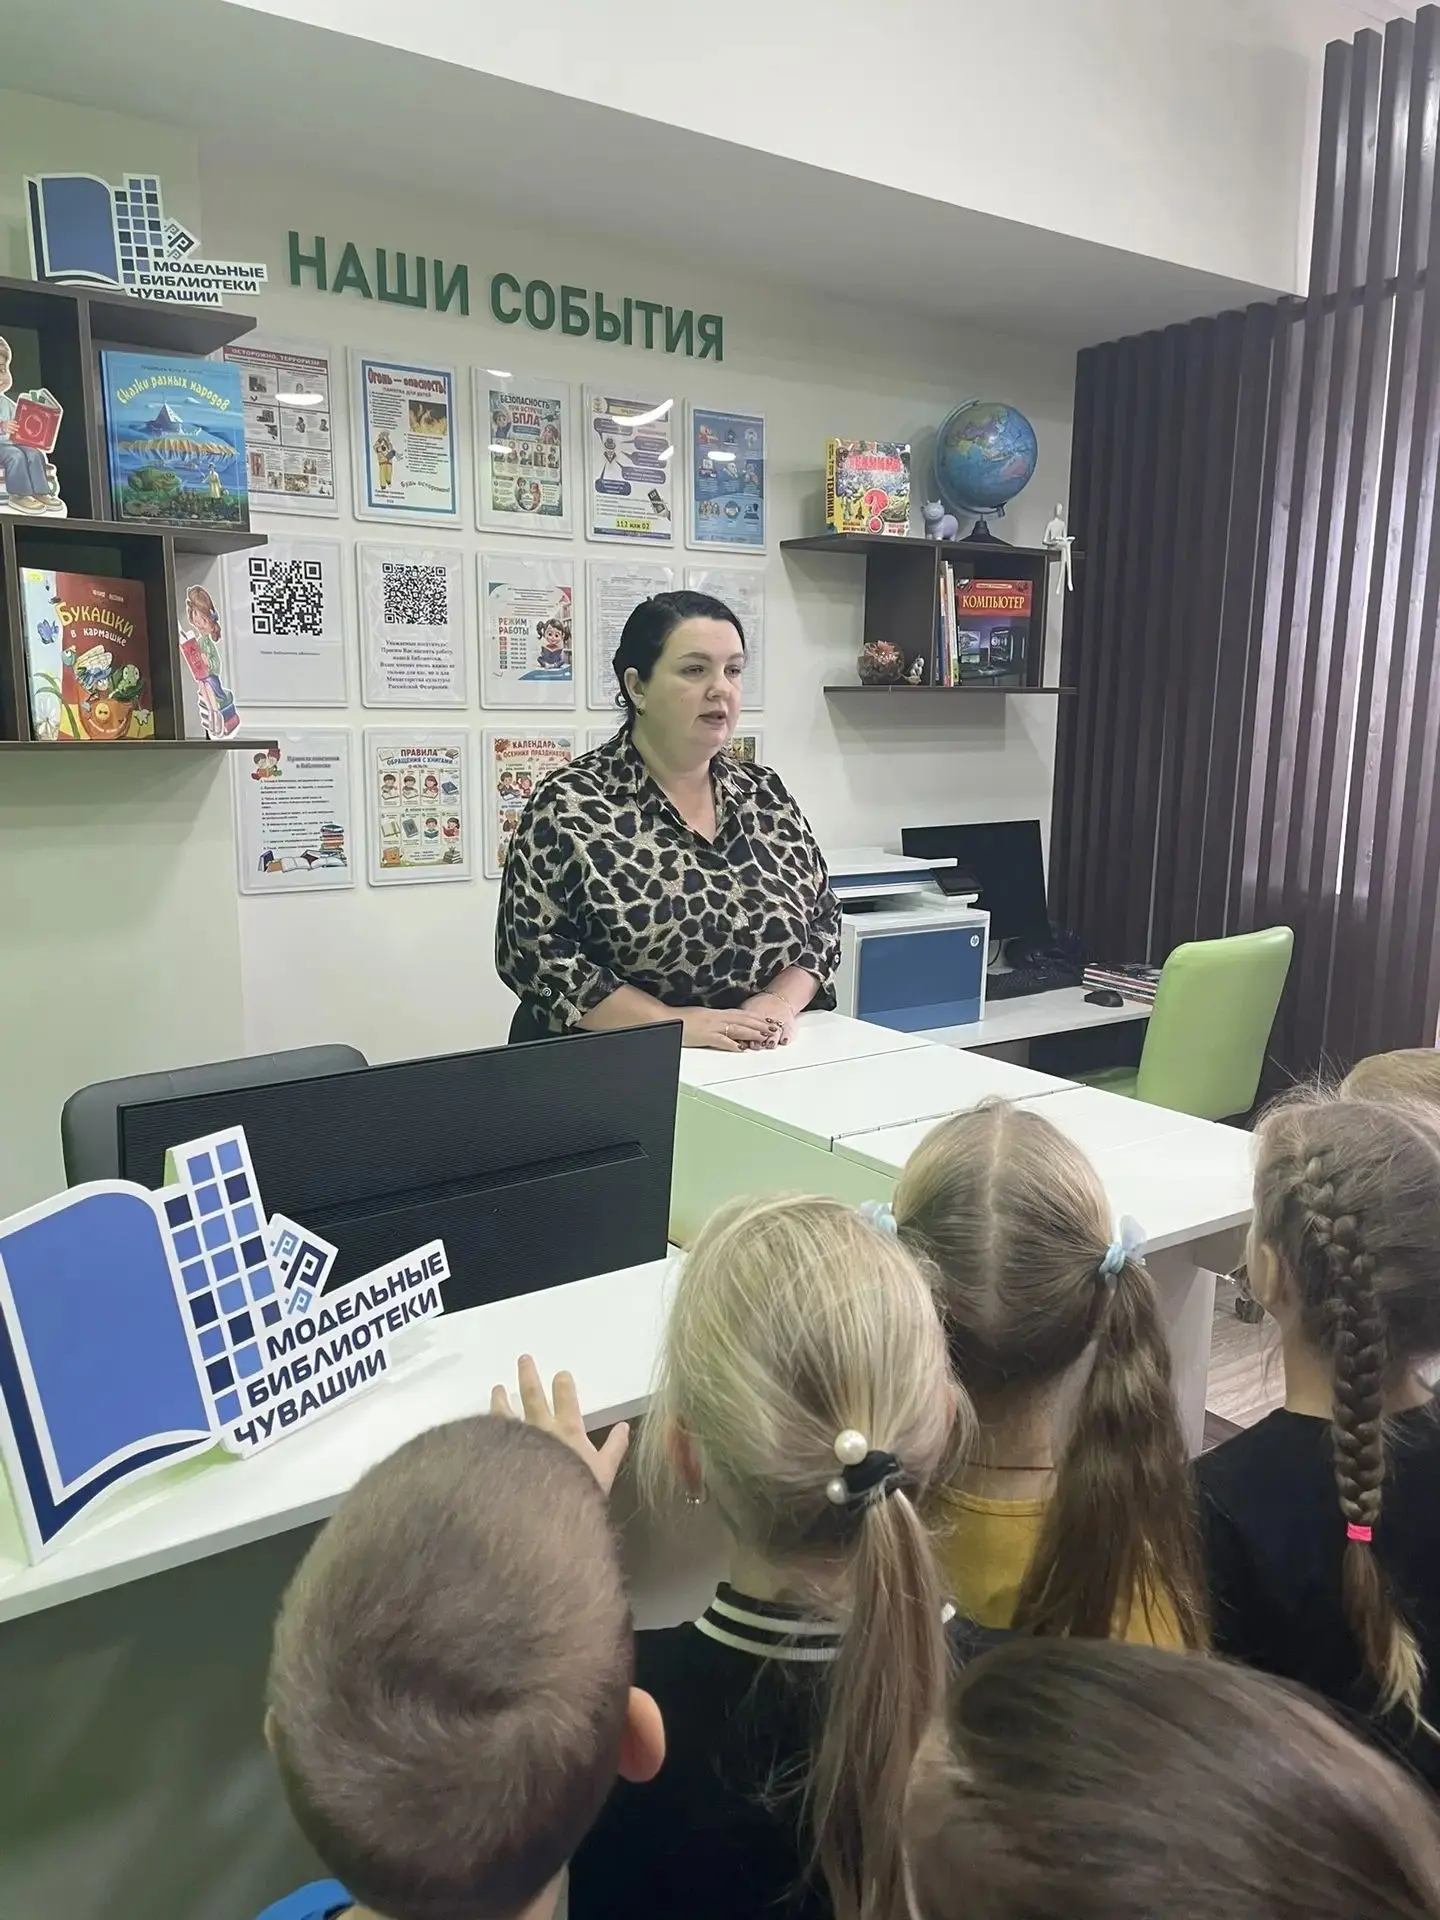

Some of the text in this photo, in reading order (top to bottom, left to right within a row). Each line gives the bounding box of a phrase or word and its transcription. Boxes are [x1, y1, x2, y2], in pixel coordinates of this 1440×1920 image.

[153, 261, 264, 278] МОДЕЛЬНЫЕ
[139, 274, 257, 292] БИБЛИОТЕКИ
[130, 287, 219, 303] ЧУВАШИИ
[288, 230, 724, 361] НАШИ СОБЫТИЯ
[368, 367, 393, 385] Огонь
[116, 375, 231, 411] Сказки разных народов
[500, 394, 550, 410] БЕЗОПАСНОСТЬ
[512, 412, 540, 426] БПЛА
[827, 476, 835, 518] ТЕХНИКА
[962, 595, 1025, 609] КОМПЬЮТЕР
[55, 602, 134, 638] БУКАШКИ
[498, 617, 527, 626] РЕЖИМ
[70, 627, 127, 647] в кармашке
[498, 626, 529, 635] РАБОТЫ
[400, 748, 438, 757] ПРАВИЛА
[512, 740, 556, 749] КАЛЕНДАРЬ
[266, 1251, 445, 1360] МОДЕЛЬНЫЕ
[246, 1287, 438, 1408] БИБЛИОТЕКИ
[234, 1349, 387, 1445] ЧУВАШИИ
